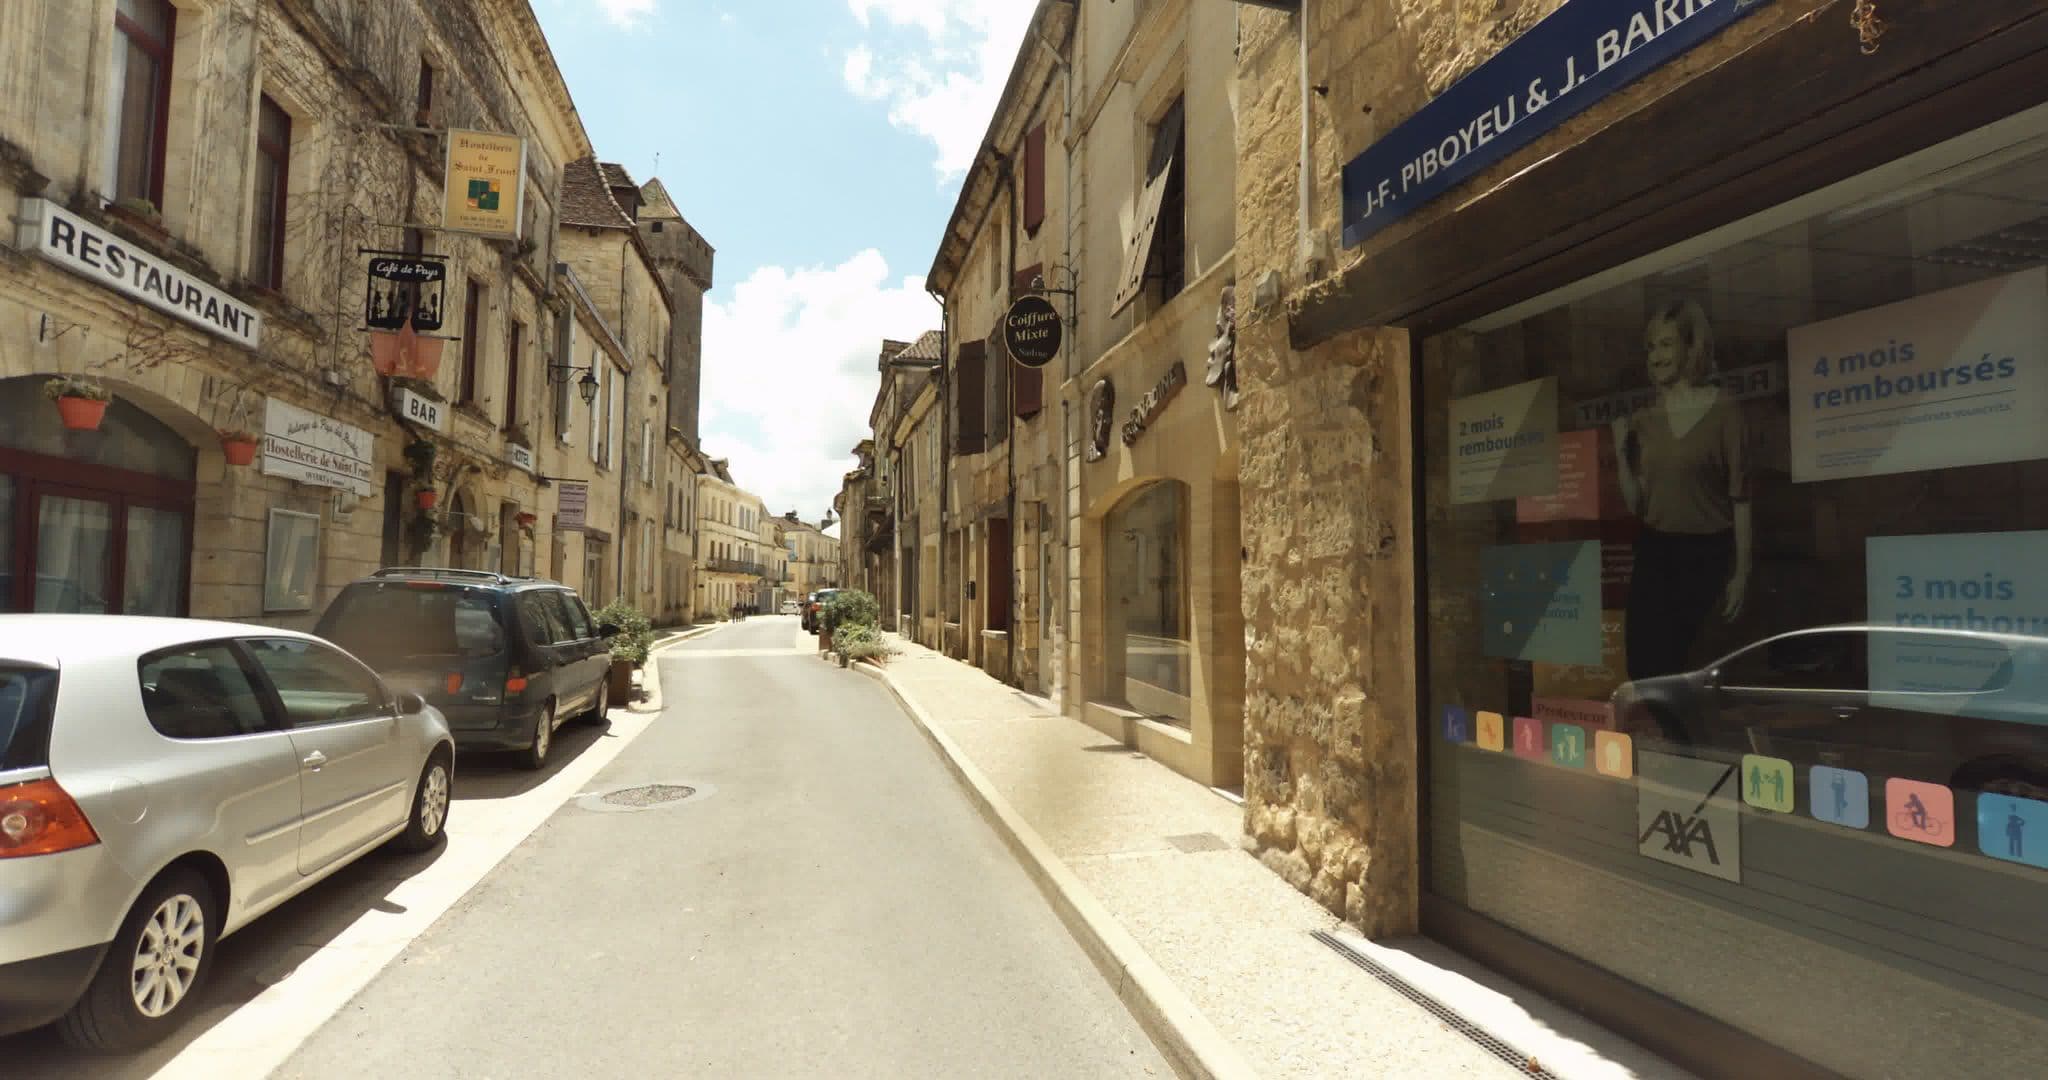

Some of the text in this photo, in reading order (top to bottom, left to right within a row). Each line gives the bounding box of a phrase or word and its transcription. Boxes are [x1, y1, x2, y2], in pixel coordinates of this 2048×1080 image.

[1363, 178, 1396, 218] J-F.
[1401, 95, 1516, 193] PIBOYEU
[1526, 77, 1551, 115] &
[1558, 55, 1587, 95] J.
[50, 215, 255, 339] RESTAURANT
[376, 261, 439, 281] Café de Pays
[1008, 311, 1056, 328] Coiffure
[1015, 328, 1049, 343] Mixte
[1812, 339, 1915, 378] 4 mois
[1812, 353, 2016, 410] remboursés
[410, 398, 438, 425] BAR
[1458, 411, 1505, 437] 2 mois
[1895, 570, 2016, 601] 3 mois
[1639, 809, 1721, 866] AXA
